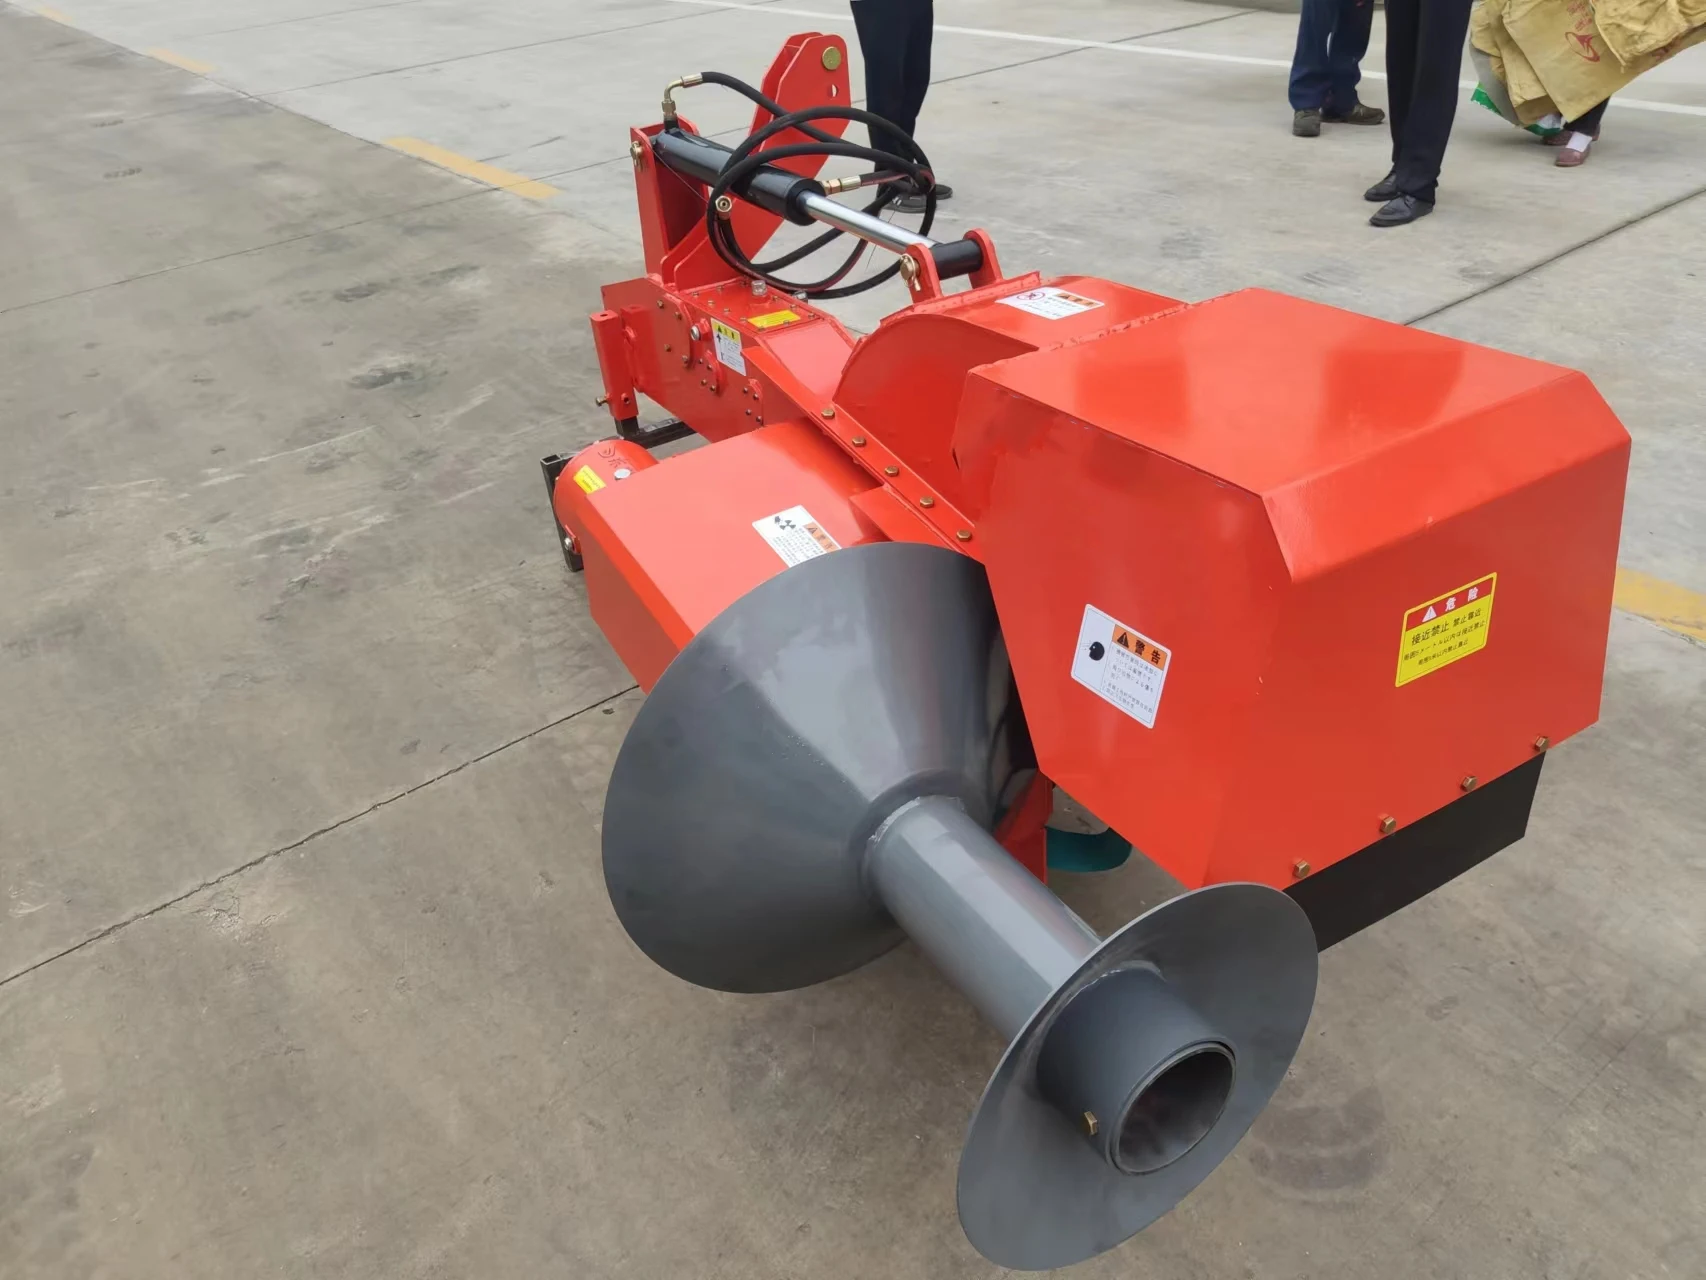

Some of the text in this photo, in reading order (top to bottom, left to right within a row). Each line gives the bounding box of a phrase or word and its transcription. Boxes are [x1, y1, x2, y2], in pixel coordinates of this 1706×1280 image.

[1411, 608, 1482, 646] 接近禁止 禁止靠近
[1135, 639, 1161, 665] 警告
